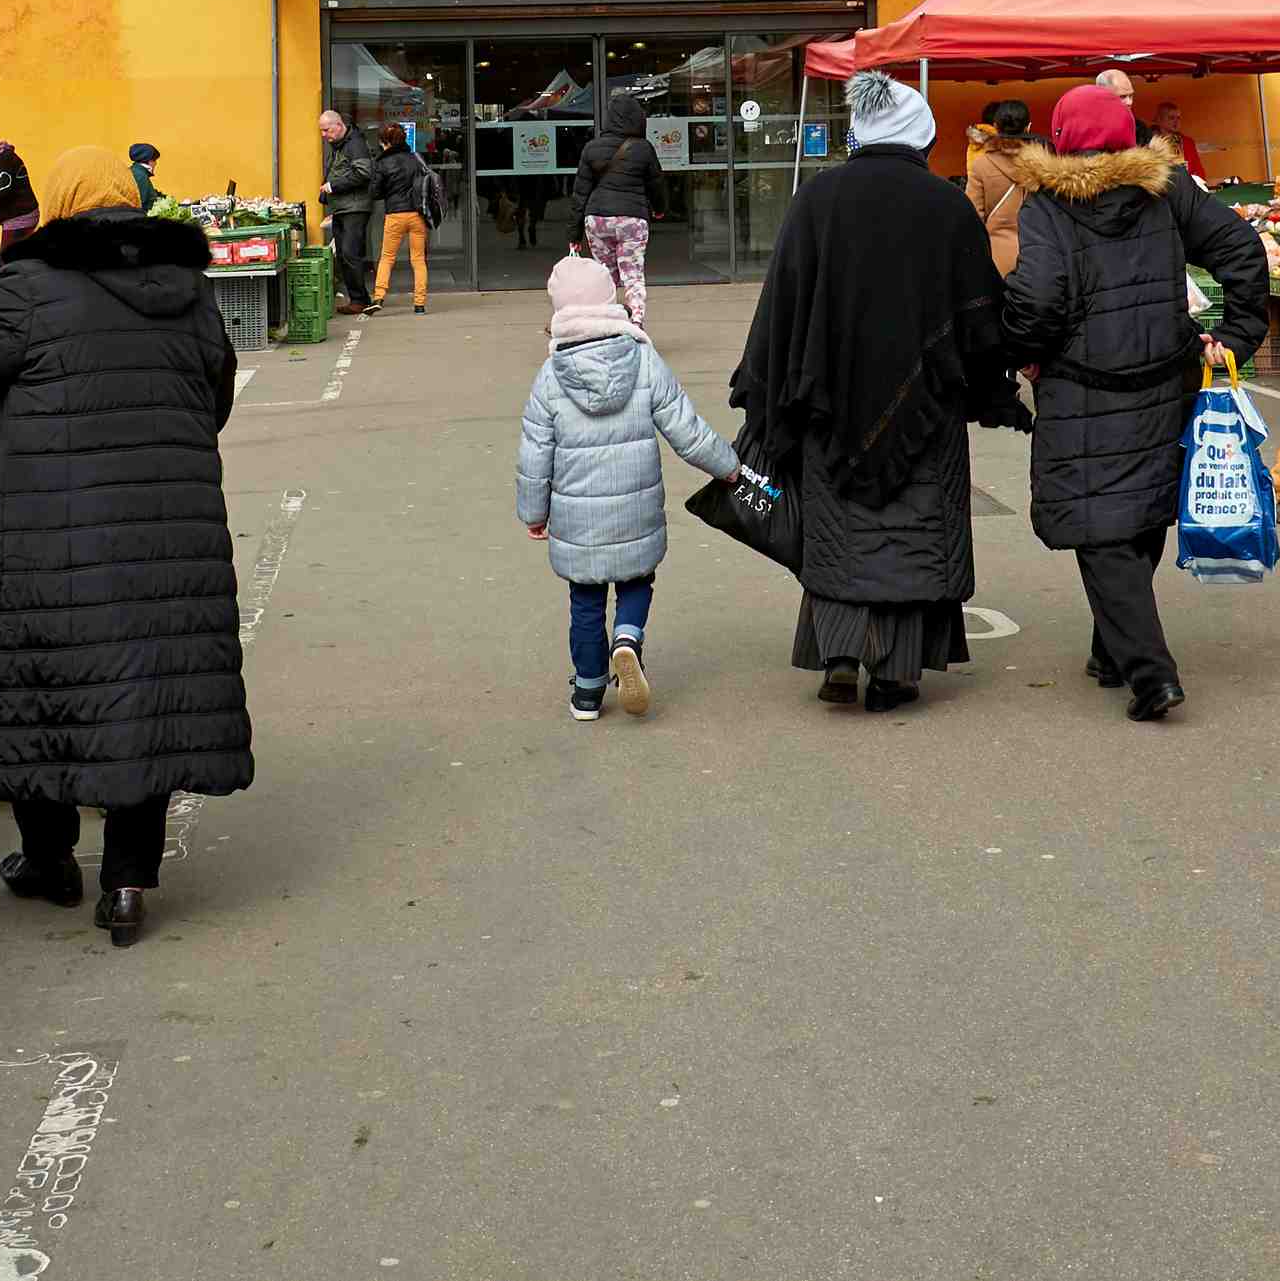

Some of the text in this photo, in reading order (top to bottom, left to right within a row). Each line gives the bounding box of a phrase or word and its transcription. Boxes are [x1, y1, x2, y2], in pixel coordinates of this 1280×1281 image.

[1230, 463, 1244, 472] que
[1195, 472, 1247, 489] du lait
[1195, 489, 1248, 501] produit en
[1194, 502, 1237, 514] France
